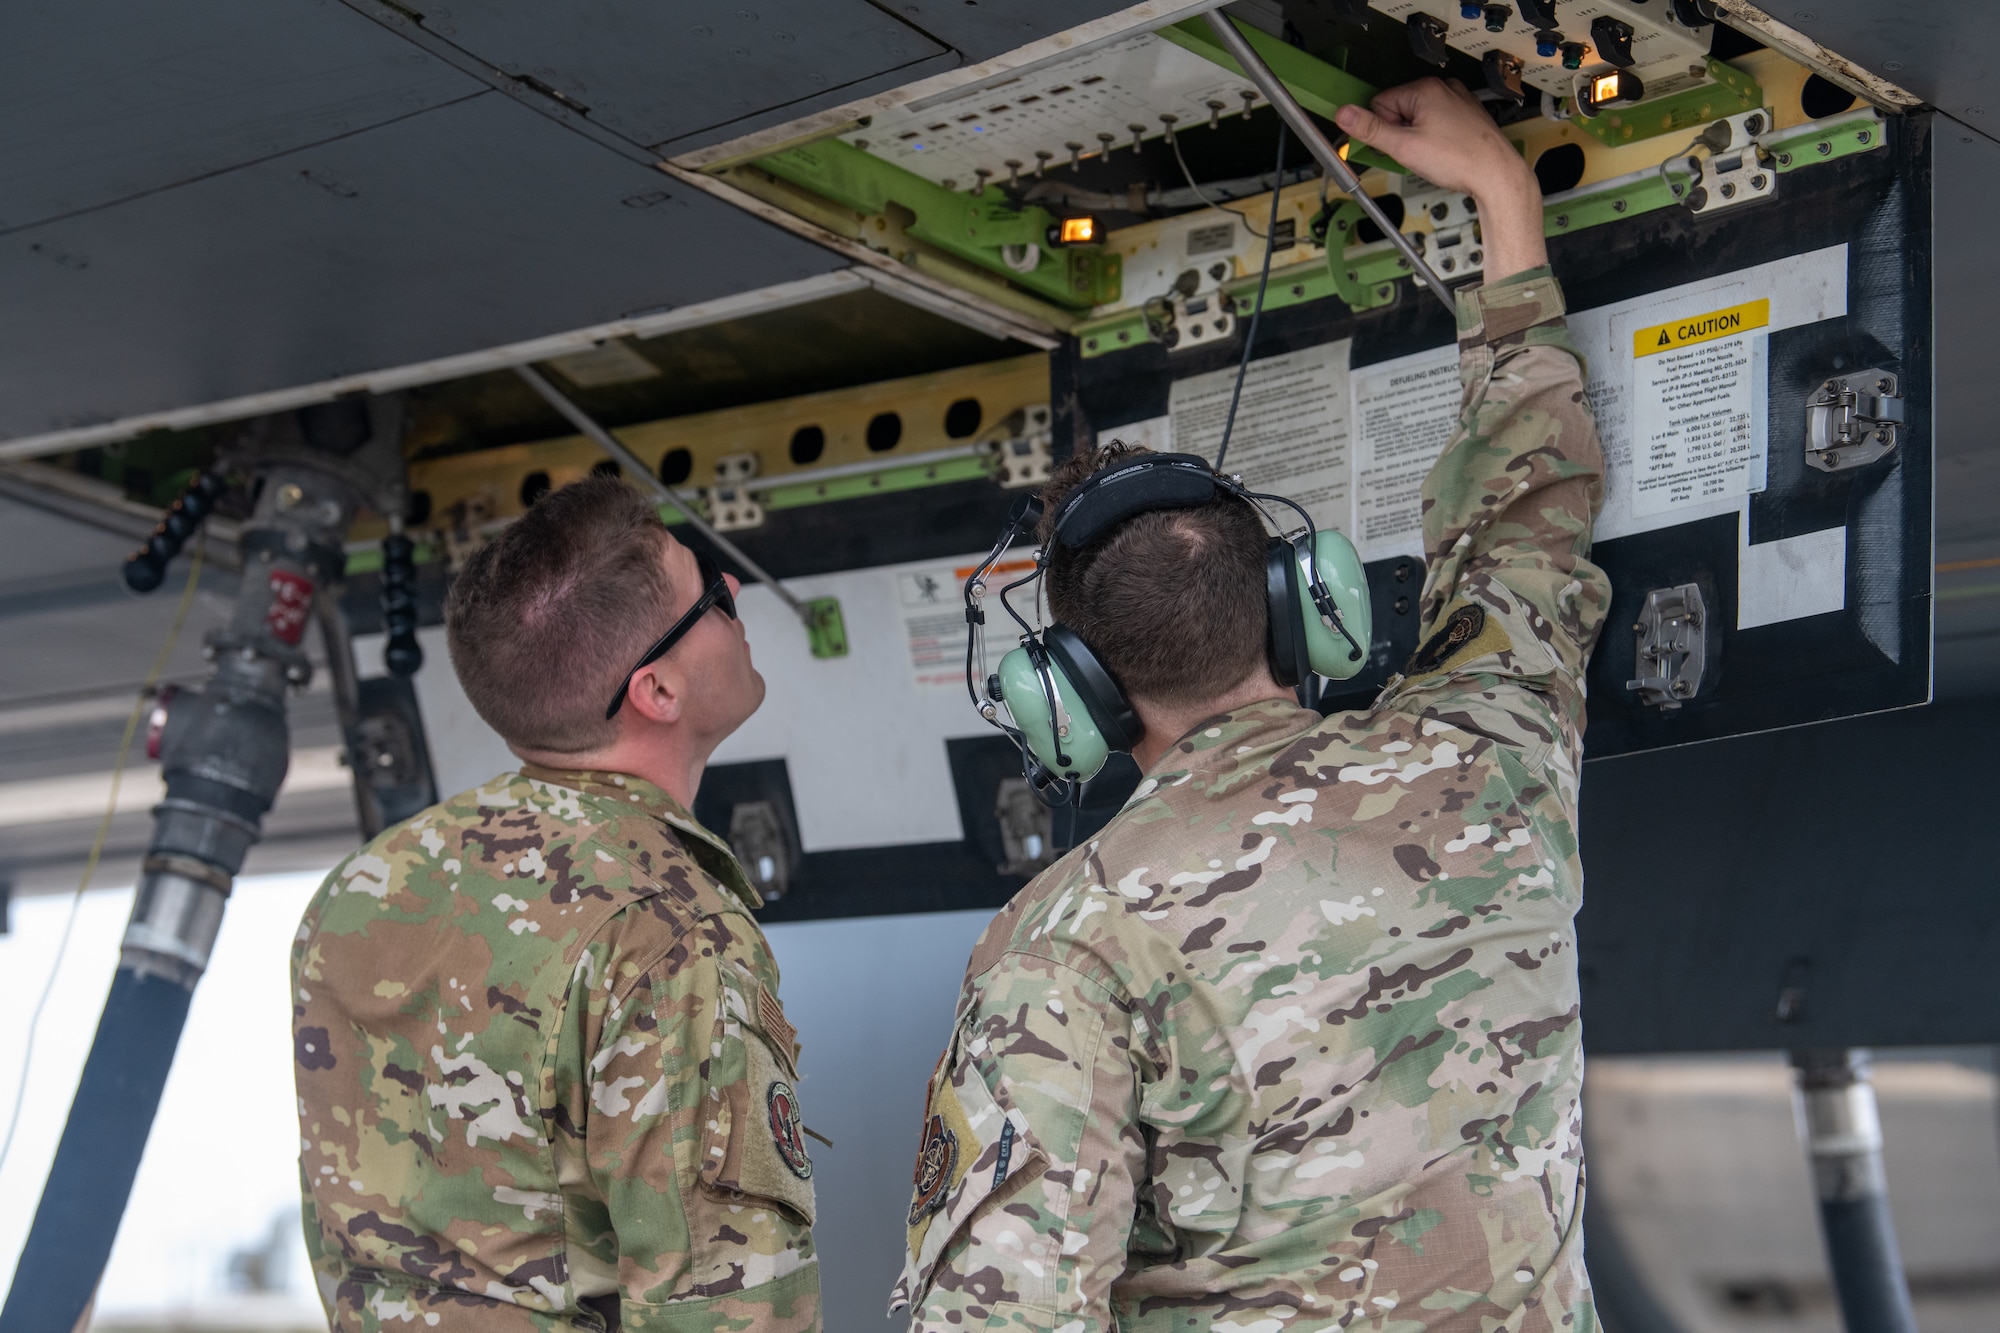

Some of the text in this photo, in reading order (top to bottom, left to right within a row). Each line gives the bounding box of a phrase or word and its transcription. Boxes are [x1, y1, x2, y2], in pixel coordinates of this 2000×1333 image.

[1386, 2, 1413, 13] OPEN
[1575, 7, 1598, 17] LEFT
[1464, 40, 1490, 50] OPEN
[1678, 313, 1740, 340] CAUTION
[1677, 352, 1693, 361] Exceed
[1734, 340, 1743, 348] kPa
[1666, 365, 1677, 373] Fuel
[1678, 360, 1698, 370] Pressure
[1390, 371, 1427, 387] DEFUELING
[1652, 377, 1668, 386] Service
[1670, 374, 1680, 382] with
[1694, 366, 1712, 377] Meeting
[1680, 379, 1699, 390] Meeting
[1662, 395, 1674, 403] Refer
[1682, 388, 1703, 400] Airplane
[1704, 385, 1717, 395] Flight
[1719, 381, 1737, 390] Manual
[1678, 401, 1691, 409] Other
[1693, 395, 1716, 407] Approved
[1669, 418, 1680, 426] Tank
[1682, 415, 1699, 423] Usable
[1712, 407, 1732, 417] Volumes
[1651, 443, 1667, 451] Center
[1713, 429, 1722, 437] Gal
[1664, 451, 1676, 459] Body
[1702, 442, 1712, 450] U.S.
[1702, 452, 1712, 460] U.S.
[1667, 470, 1692, 480] temperature
[1668, 478, 1688, 486] quantities
